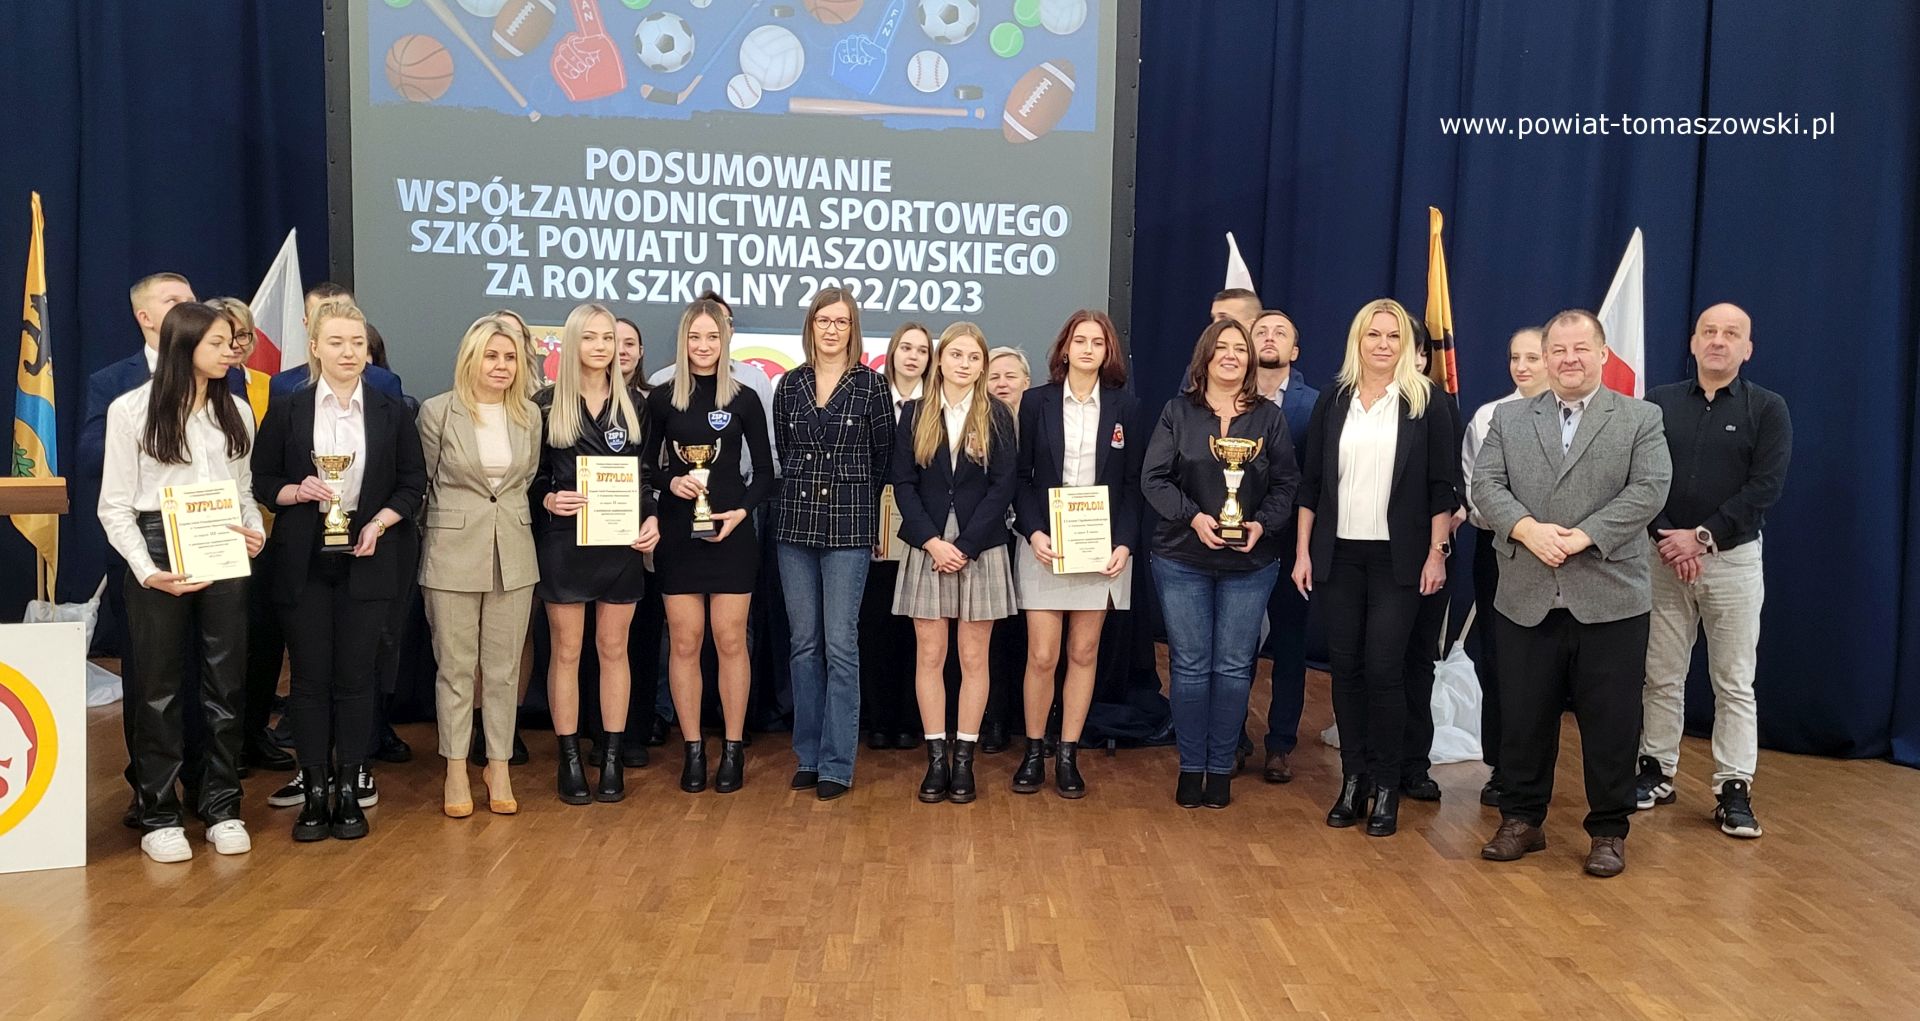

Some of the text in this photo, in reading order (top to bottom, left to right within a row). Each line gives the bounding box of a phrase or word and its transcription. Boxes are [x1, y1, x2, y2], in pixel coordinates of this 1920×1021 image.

[882, 8, 900, 37] FAN
[585, 147, 892, 193] PODSUMOWANIE
[396, 176, 1069, 238] WSPÓŁZAWODNICTWA SPORTOWEGO
[410, 216, 1057, 277] SZKÓŁ POWIATU TOMASZOWSKIEGO
[485, 262, 535, 297] ZA
[543, 264, 620, 301] ROK
[626, 268, 793, 307] SZKOLNY
[595, 472, 634, 482] DYPLOM
[185, 498, 233, 513] DYPLOM
[1067, 500, 1105, 512] DYPLOM
